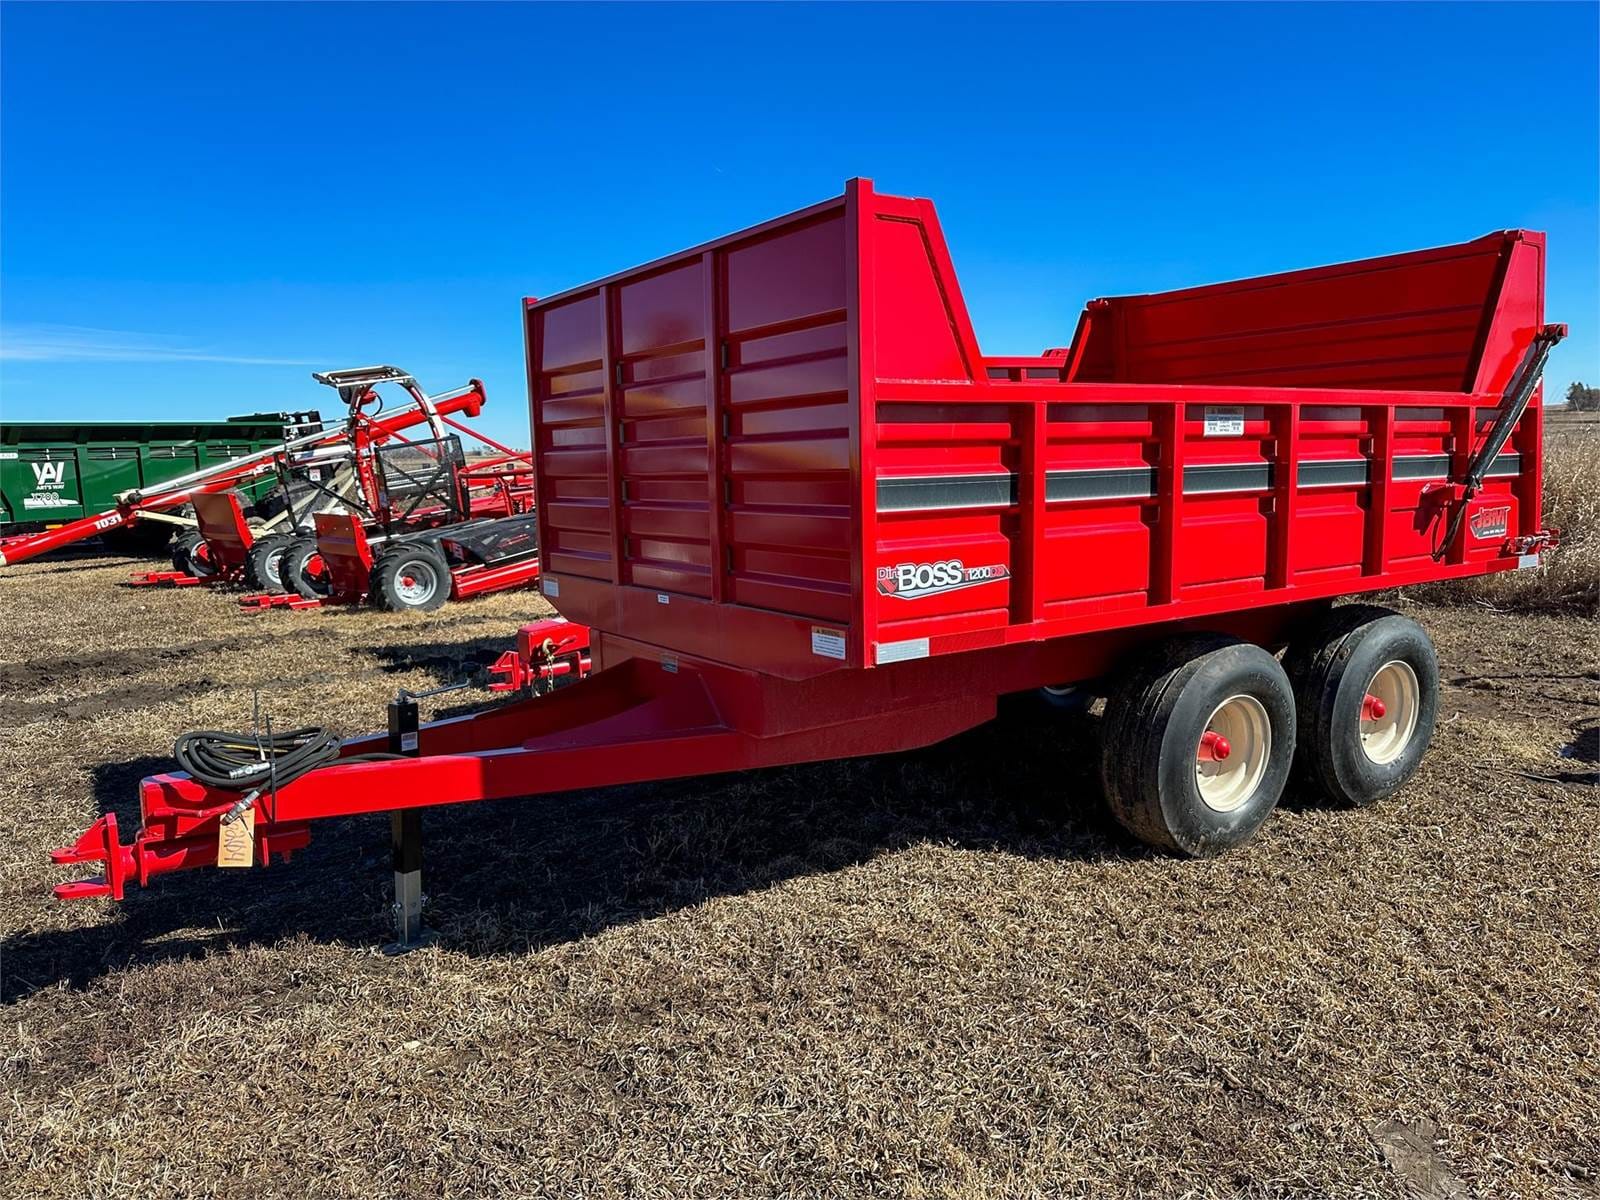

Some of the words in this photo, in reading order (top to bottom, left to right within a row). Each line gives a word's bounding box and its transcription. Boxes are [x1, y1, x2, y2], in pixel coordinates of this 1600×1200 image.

[95, 513, 123, 530] 1031
[878, 567, 899, 579] Dirt
[898, 561, 962, 591] BOSS
